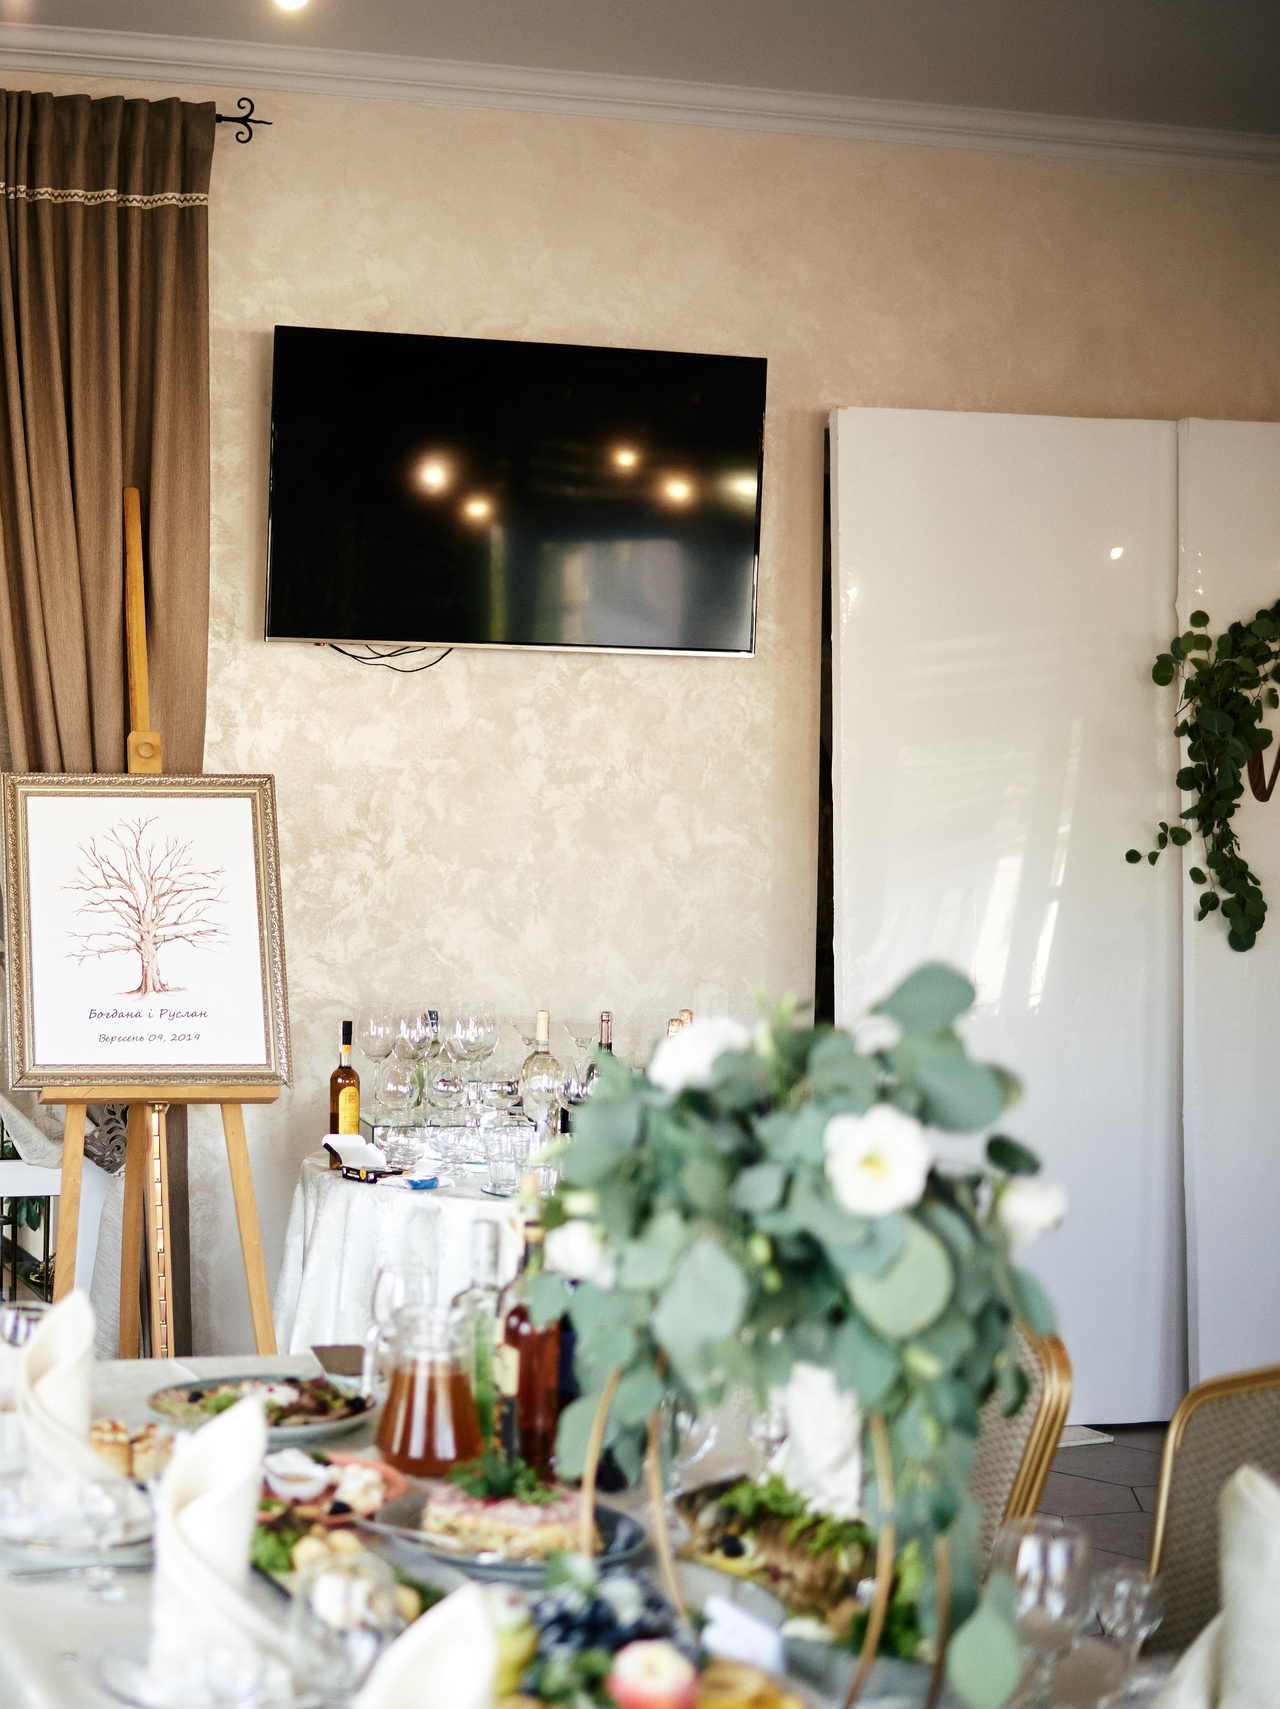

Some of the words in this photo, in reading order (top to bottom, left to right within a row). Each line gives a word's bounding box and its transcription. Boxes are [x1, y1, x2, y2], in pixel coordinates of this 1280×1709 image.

[88, 1008, 143, 1019] Богдана
[147, 1008, 154, 1019] і
[159, 1008, 209, 1021] Руслан
[98, 1033, 145, 1044] Вересень
[148, 1033, 167, 1043] 09,
[169, 1033, 201, 1042] 2019
